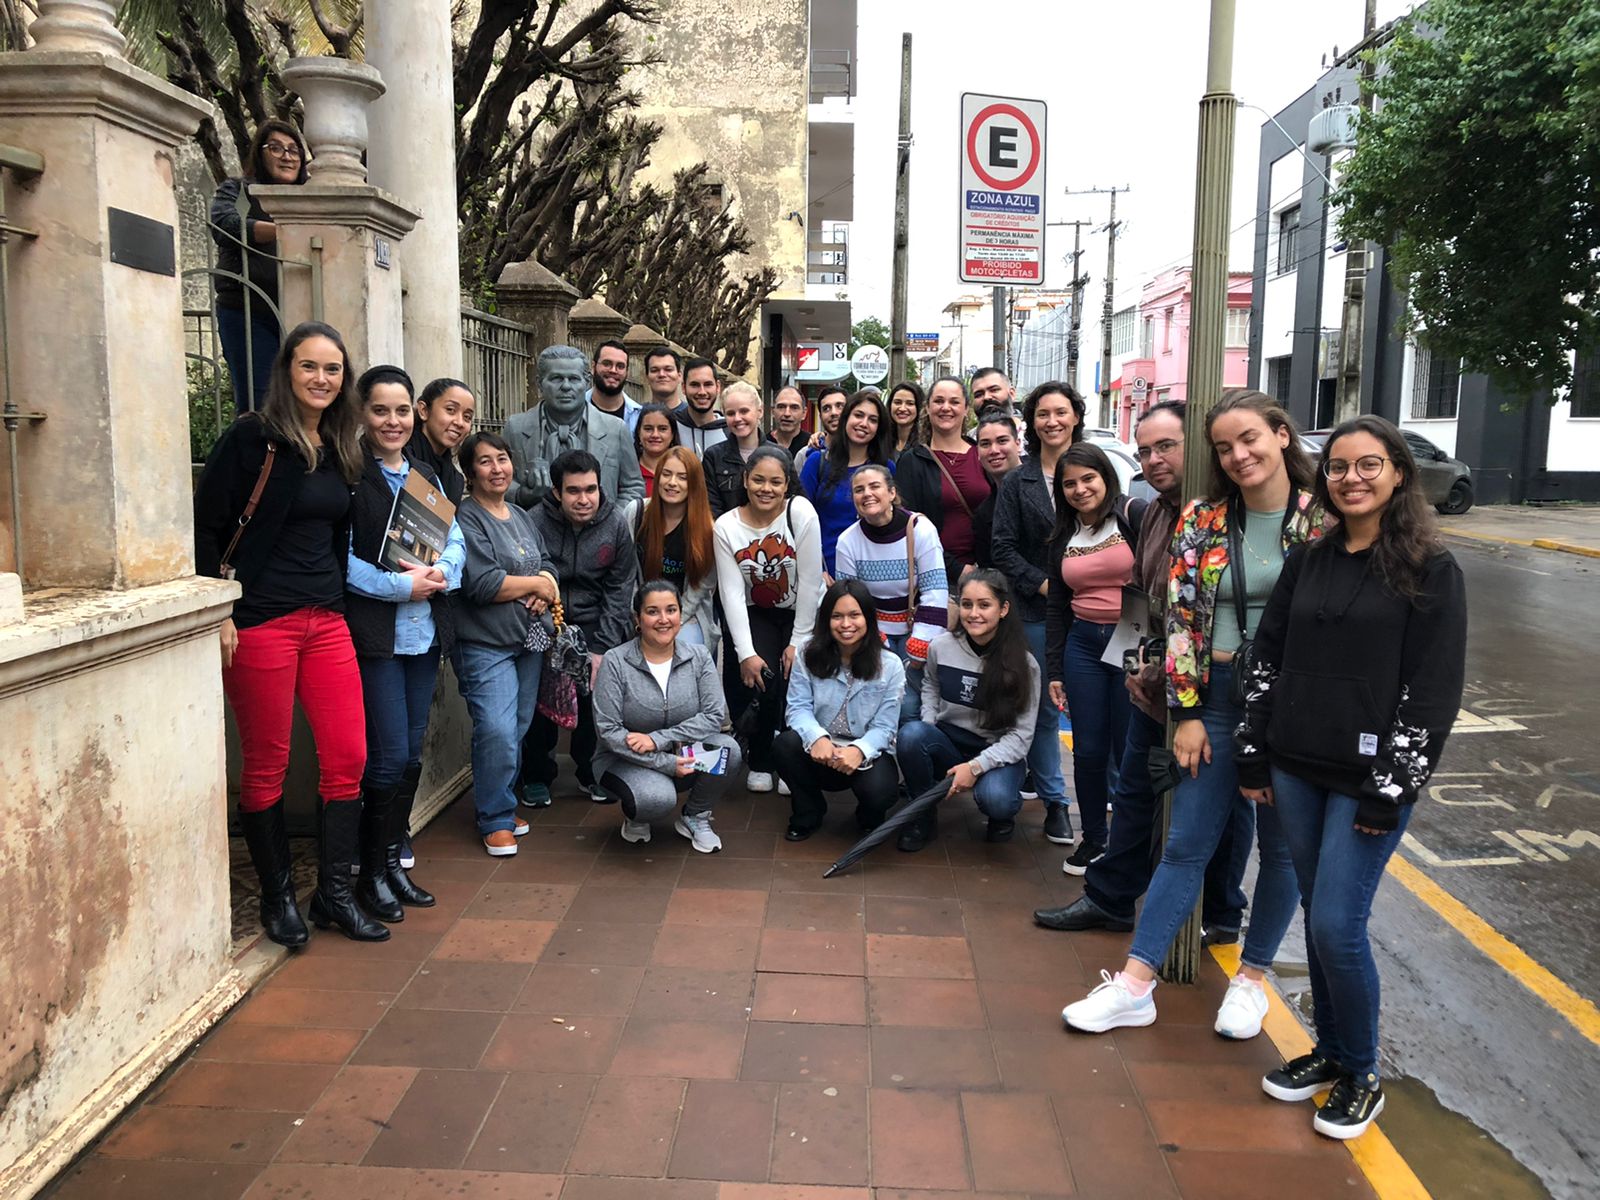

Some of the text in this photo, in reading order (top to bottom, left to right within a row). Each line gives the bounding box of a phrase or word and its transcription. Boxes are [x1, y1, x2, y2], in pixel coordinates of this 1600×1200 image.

[989, 125, 1018, 169] E
[971, 192, 1035, 208] ZONA AZUL
[1012, 231, 1034, 239] MÁXIMA
[982, 260, 1022, 269] PROIBIDO
[971, 267, 1034, 277] MOTOCICLETAS
